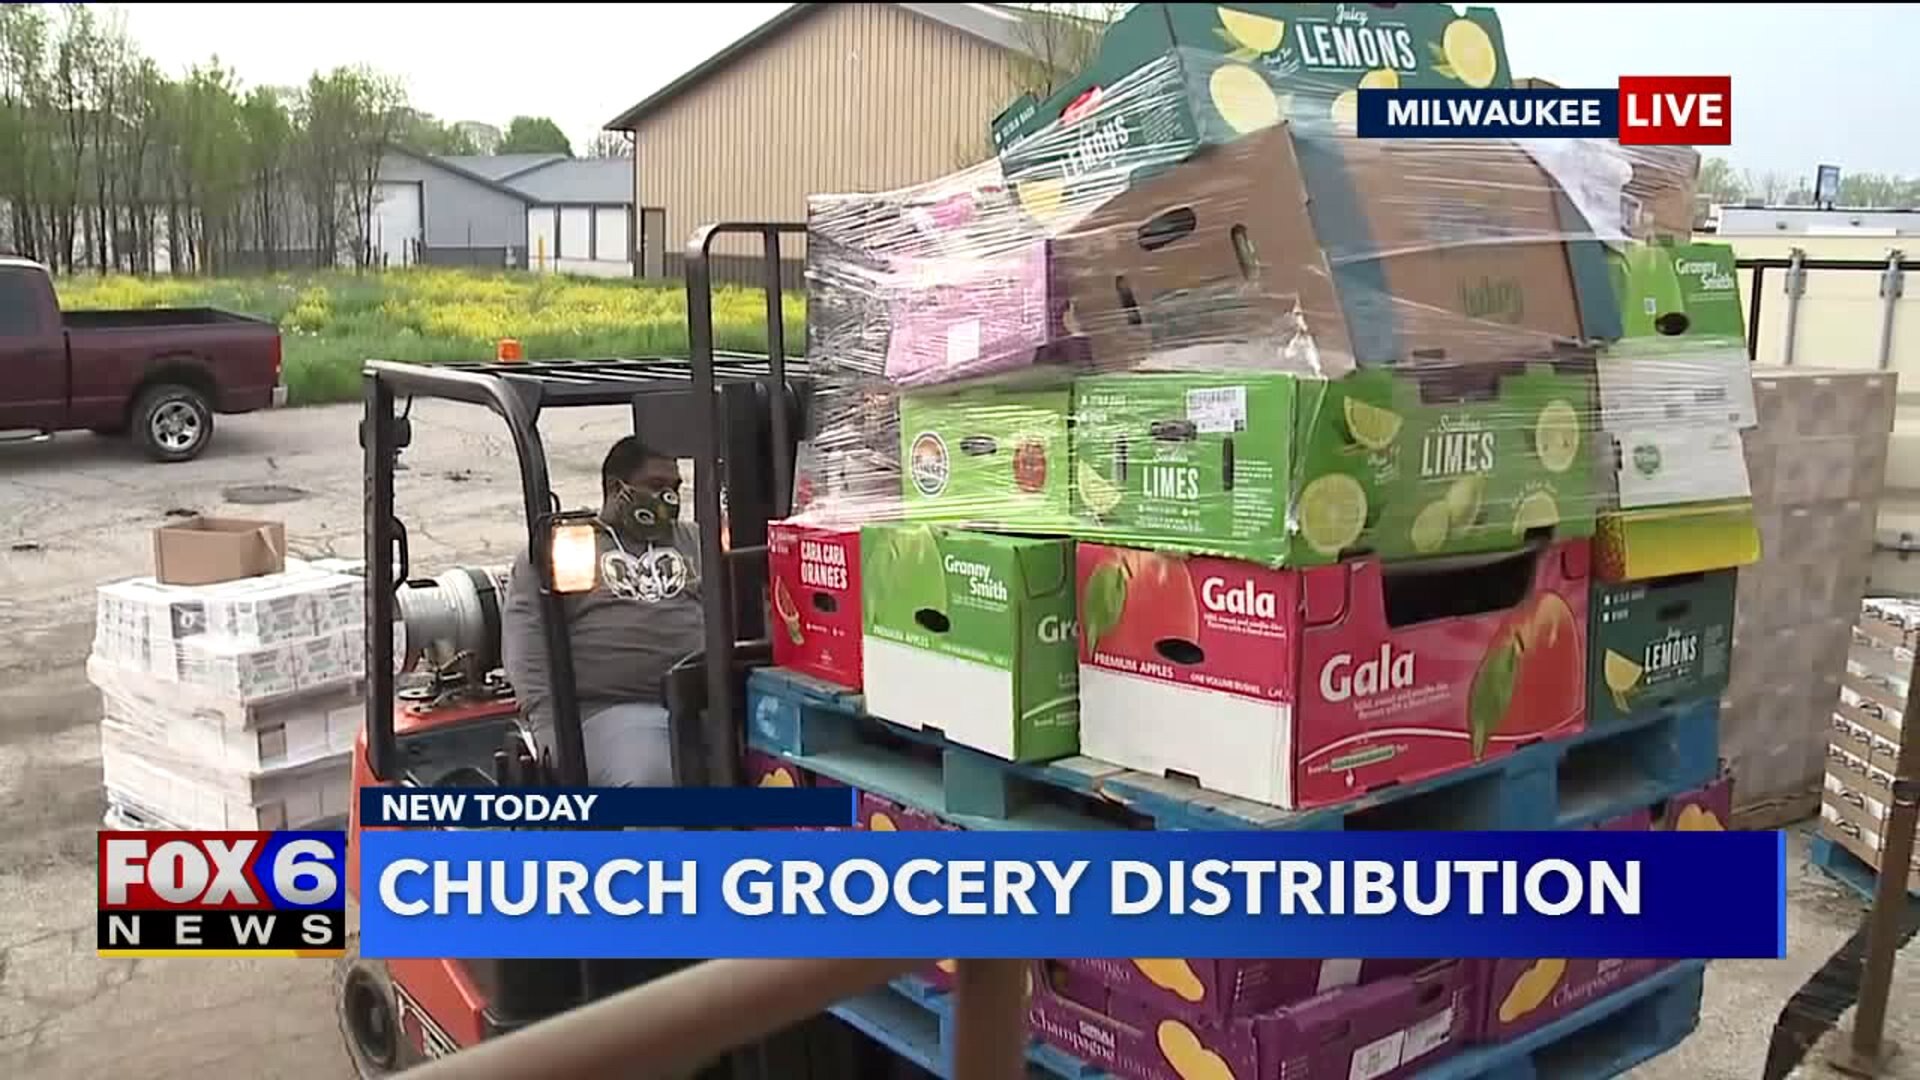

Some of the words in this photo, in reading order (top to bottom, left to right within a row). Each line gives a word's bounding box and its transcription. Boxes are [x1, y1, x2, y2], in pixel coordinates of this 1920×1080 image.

[1295, 23, 1417, 70] LEMONS
[1042, 115, 1130, 183] LEMONS
[1421, 430, 1495, 477] LIMES
[1143, 466, 1200, 501] LIMES
[800, 560, 848, 591] ORANGES
[944, 554, 991, 583] Granny
[969, 576, 1008, 601] Smith
[1202, 576, 1276, 619] Gala
[1094, 652, 1138, 672] PREMIUM
[1139, 660, 1176, 680] APPLES
[1319, 643, 1416, 702] Gala
[1644, 635, 1698, 673] LEMONS
[1029, 1007, 1116, 1062] Champagne
